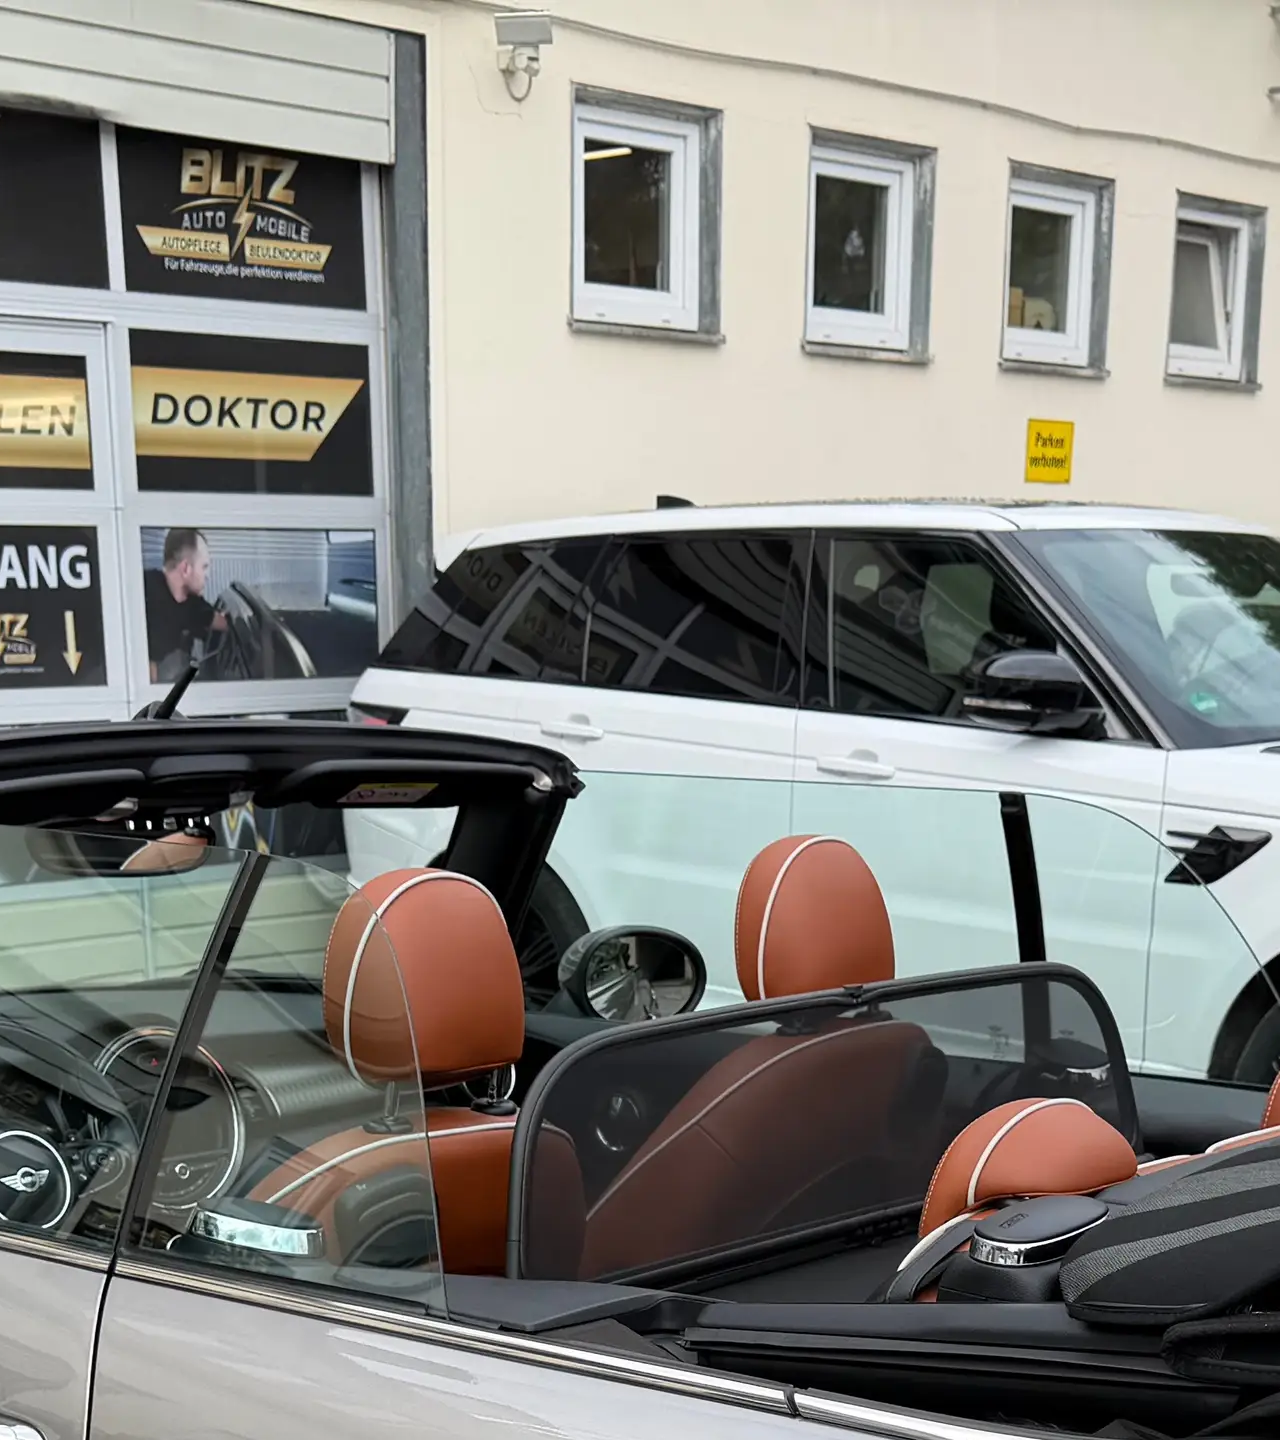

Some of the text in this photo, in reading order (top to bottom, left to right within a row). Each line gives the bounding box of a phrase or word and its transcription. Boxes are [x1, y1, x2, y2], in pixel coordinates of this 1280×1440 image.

[181, 148, 299, 204] BLITZ
[182, 211, 310, 242] AUTO MOBILE
[151, 392, 326, 433] DOKTOR
